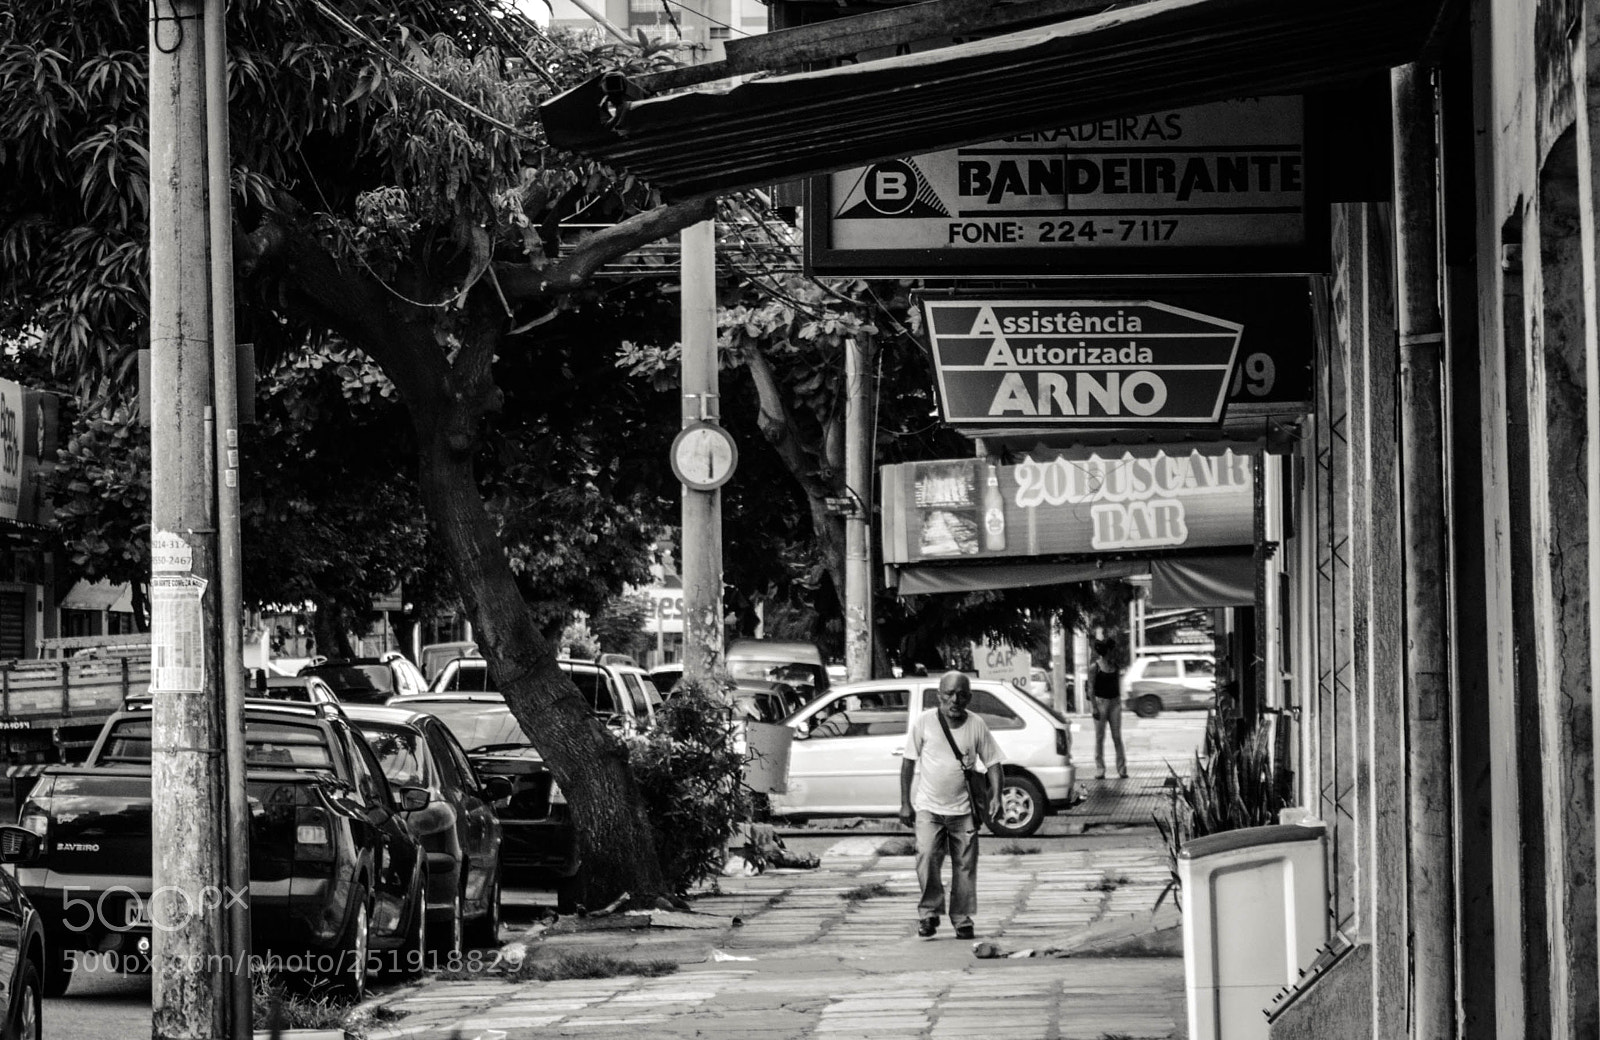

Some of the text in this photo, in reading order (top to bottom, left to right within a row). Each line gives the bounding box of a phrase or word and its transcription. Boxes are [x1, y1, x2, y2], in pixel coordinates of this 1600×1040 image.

[958, 156, 1301, 204] BANDEIRANTE
[950, 220, 1179, 243] FONE: 224-7117
[969, 305, 1142, 335] Assistência
[984, 336, 1153, 366] Autorizada
[988, 370, 1168, 416] ARNO
[1231, 352, 1276, 397] 9
[1093, 501, 1187, 547] BAR
[57, 843, 100, 852] SAVEIRO
